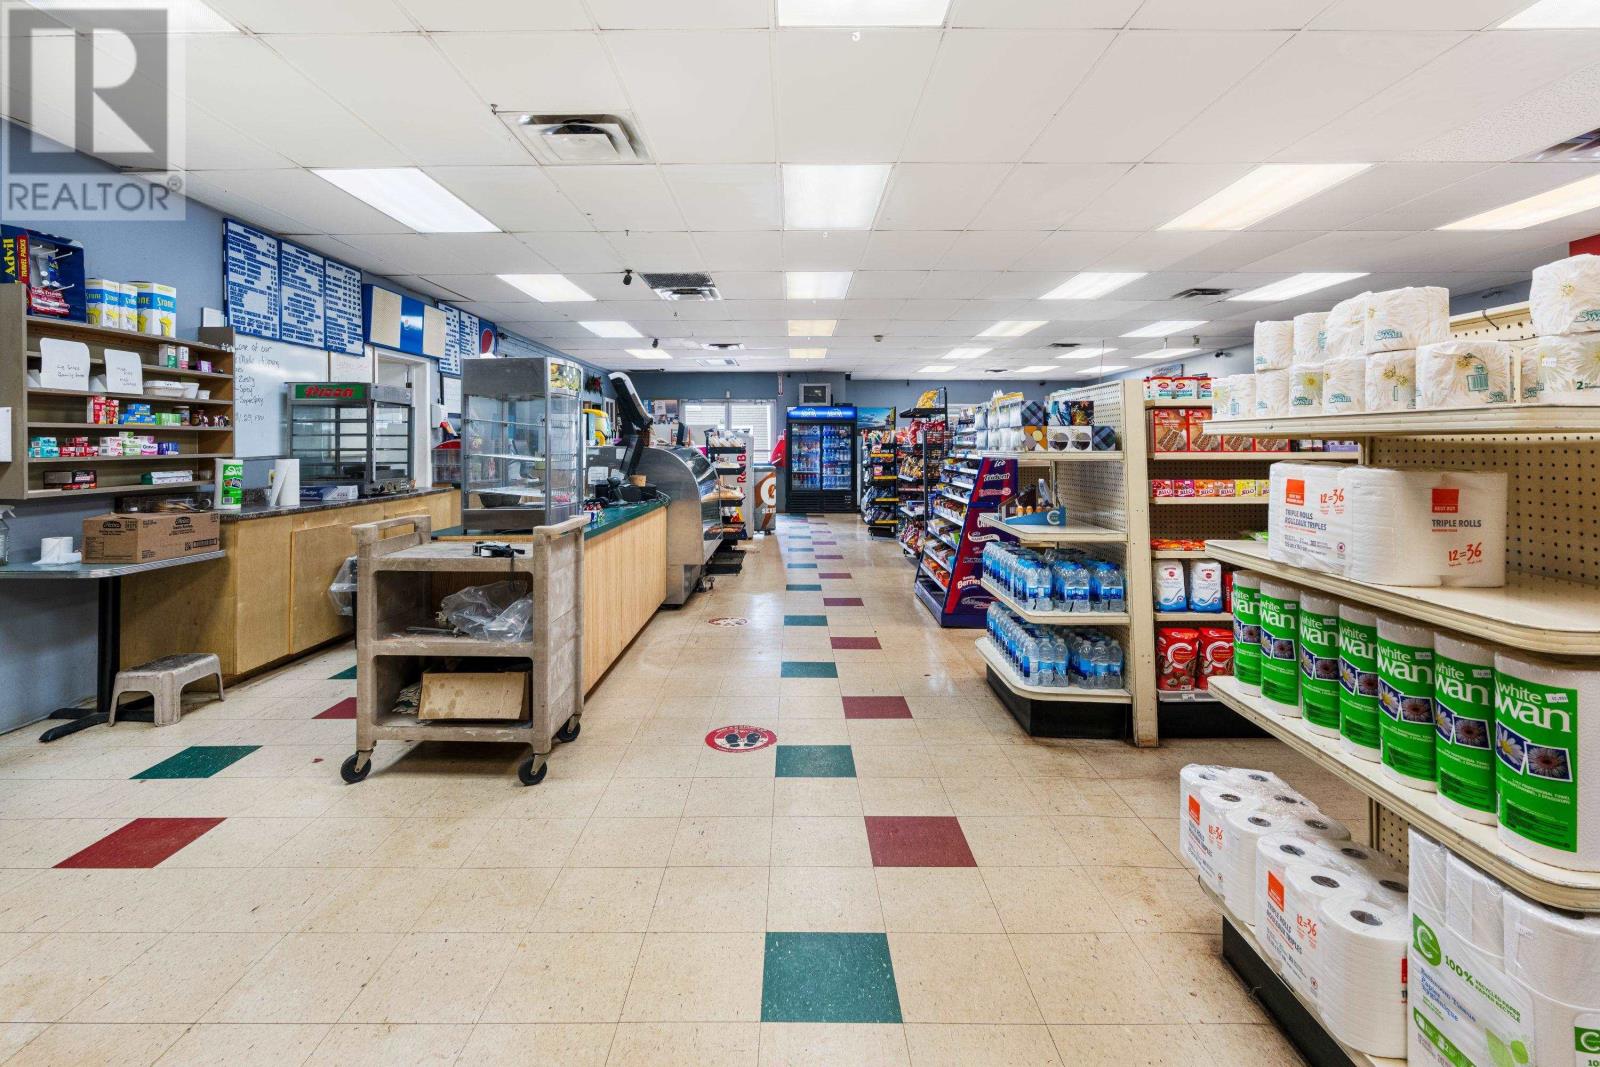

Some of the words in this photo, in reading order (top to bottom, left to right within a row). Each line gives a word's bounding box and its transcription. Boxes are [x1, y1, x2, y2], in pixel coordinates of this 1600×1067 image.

[3, 238, 15, 277] Advil
[1575, 380, 1585, 390] 2
[983, 472, 1011, 482] Trident
[1285, 508, 1300, 518] TRIPLE
[1299, 510, 1314, 520] ROLLS
[1431, 519, 1457, 528] TRIPLE
[1458, 519, 1482, 528] ROLLS
[1307, 521, 1327, 531] TRIPLES
[957, 578, 981, 590] Berries
[1260, 607, 1296, 630] wan
[1300, 624, 1340, 648] wan
[1339, 626, 1368, 641] white
[1380, 644, 1411, 663] white
[1377, 652, 1434, 685] wan
[1436, 661, 1465, 680] white
[1435, 673, 1490, 706] wan
[1498, 681, 1542, 705] white
[1495, 690, 1573, 734] wan
[1445, 955, 1475, 987] 100%
